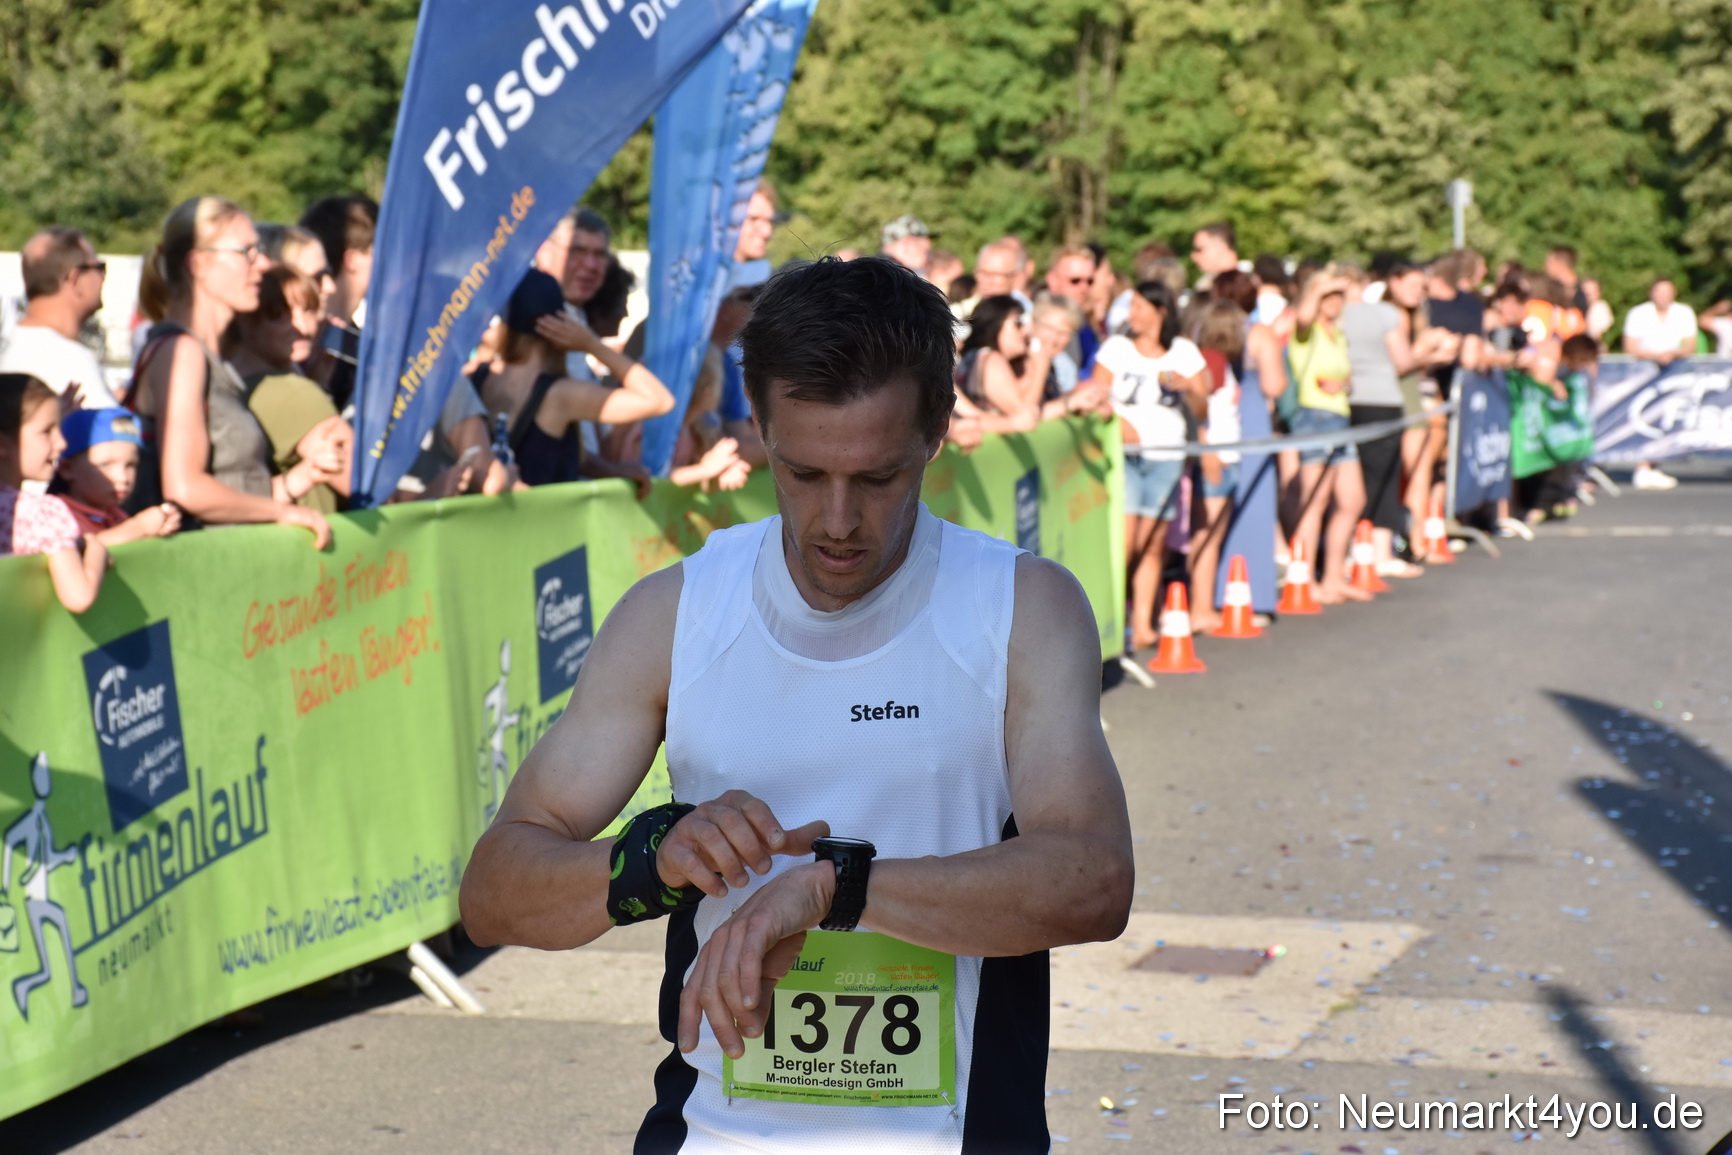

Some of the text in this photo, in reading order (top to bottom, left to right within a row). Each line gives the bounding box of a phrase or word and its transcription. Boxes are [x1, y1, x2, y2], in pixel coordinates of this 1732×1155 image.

[106, 682, 166, 734] Fischer
[850, 700, 919, 722] Stefan
[78, 734, 270, 946] firmenlauf
[98, 900, 175, 987] neumarkt
[835, 971, 876, 986] 2018
[773, 1054, 897, 1076] Bergler Stefan
[765, 1072, 904, 1090] M-motion-design GmbH
